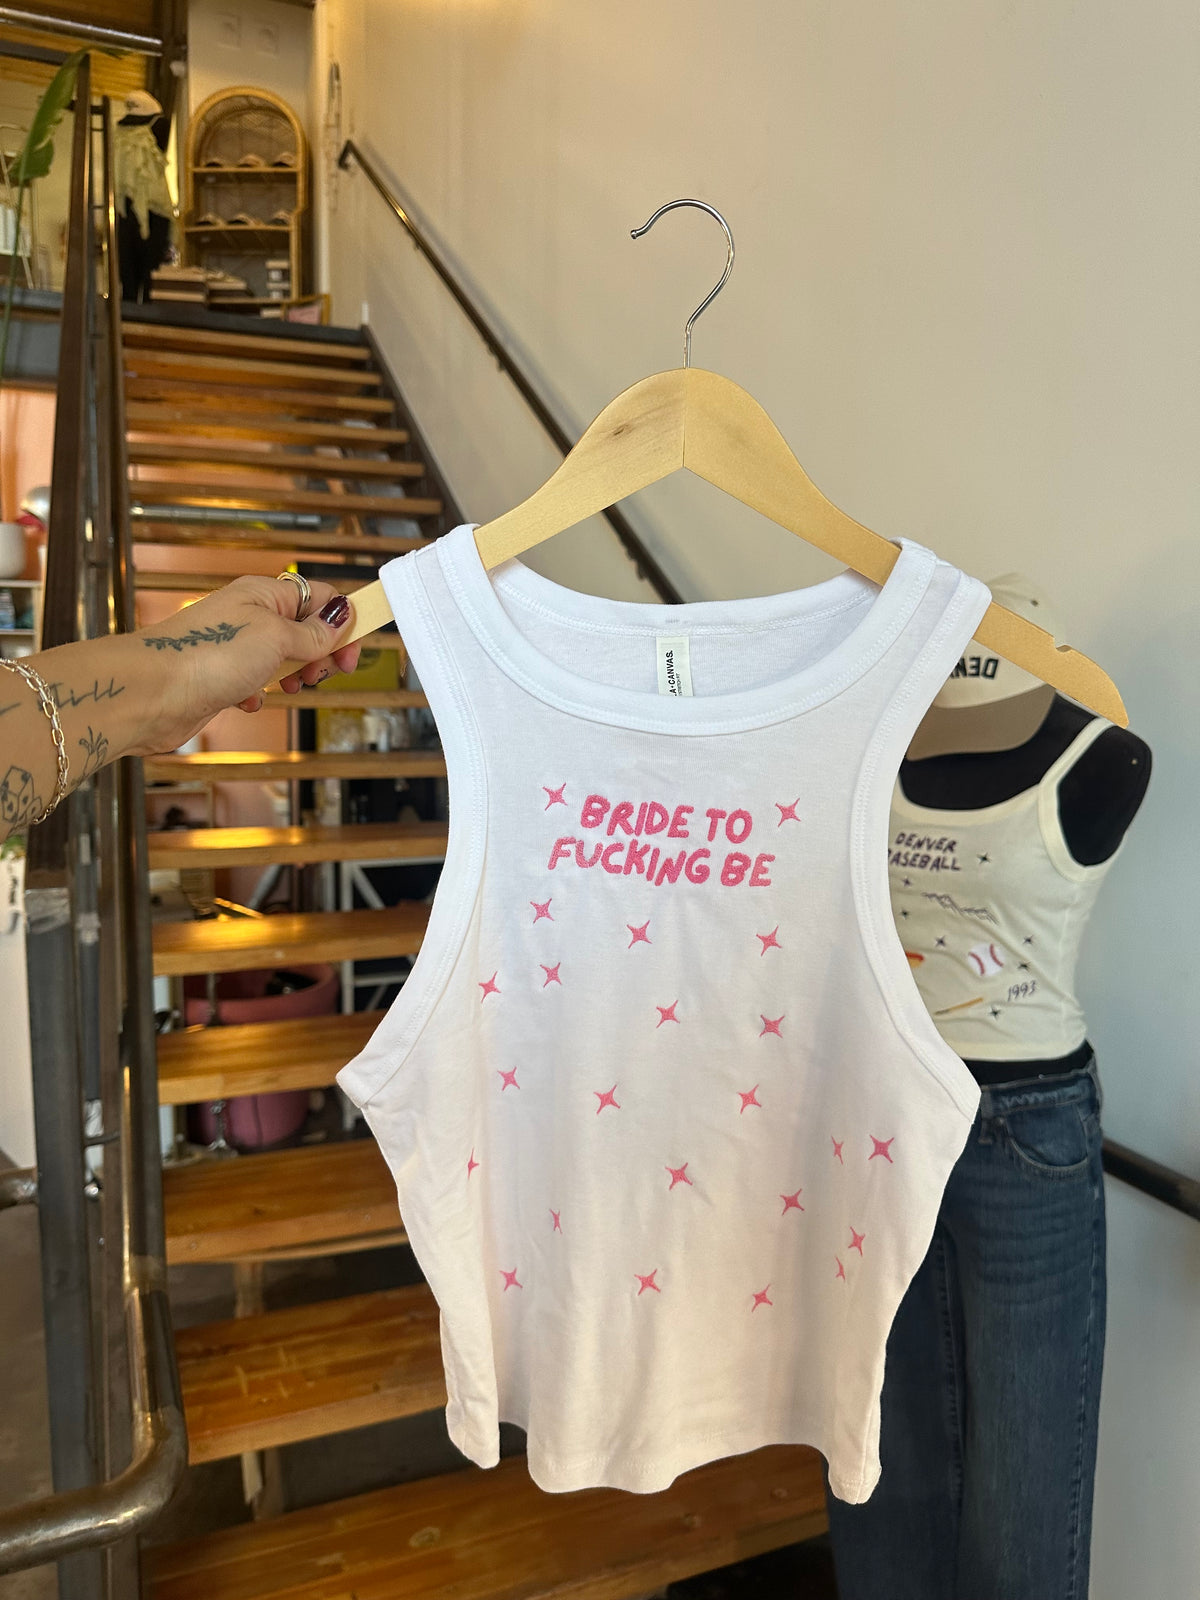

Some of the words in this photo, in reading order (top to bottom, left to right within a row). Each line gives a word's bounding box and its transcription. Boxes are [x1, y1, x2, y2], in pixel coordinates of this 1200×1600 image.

[949, 656, 999, 680] DEN
[580, 794, 695, 838] BRIDE
[706, 808, 753, 844] TO
[895, 831, 957, 854] DENVER
[547, 836, 711, 887] FUCKING
[720, 852, 776, 887] BE
[1007, 979, 1037, 1002] 1993
